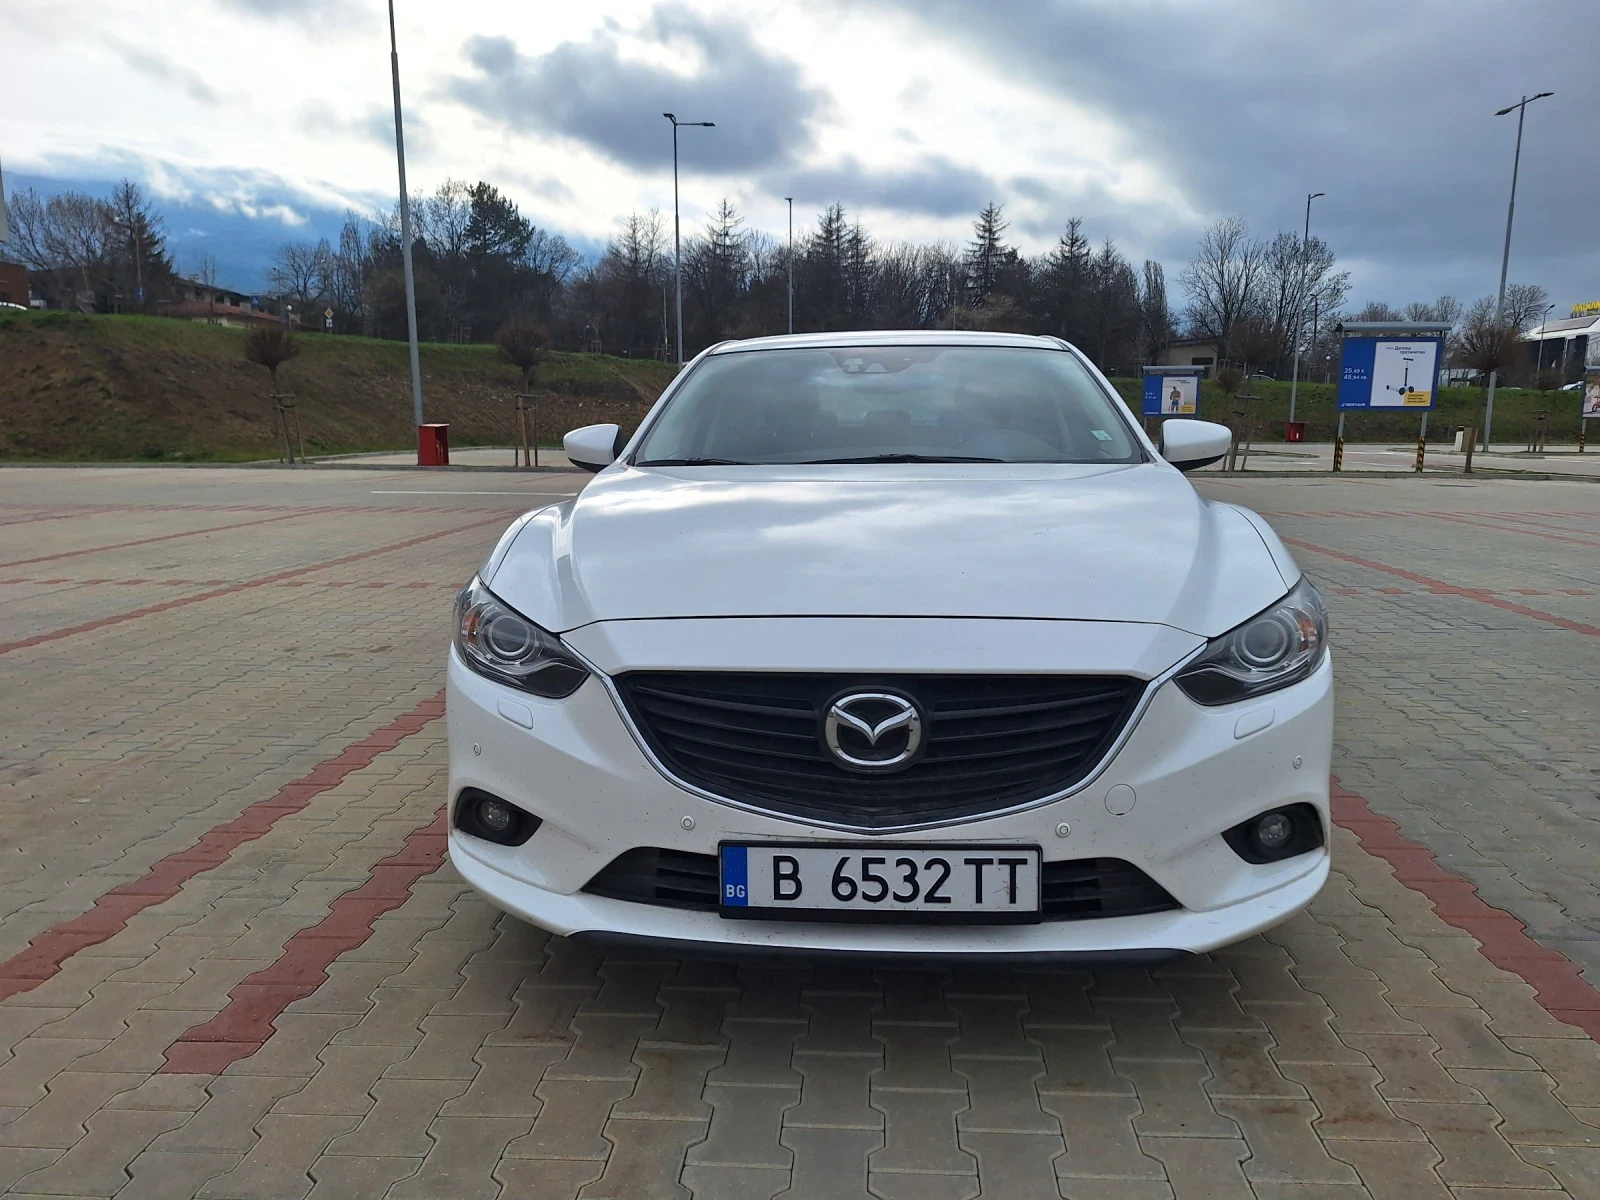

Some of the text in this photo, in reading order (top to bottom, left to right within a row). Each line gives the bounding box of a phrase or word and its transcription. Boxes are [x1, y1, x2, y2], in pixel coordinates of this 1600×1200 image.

[725, 884, 746, 898] BG
[773, 855, 1028, 905] B 6532 TT
